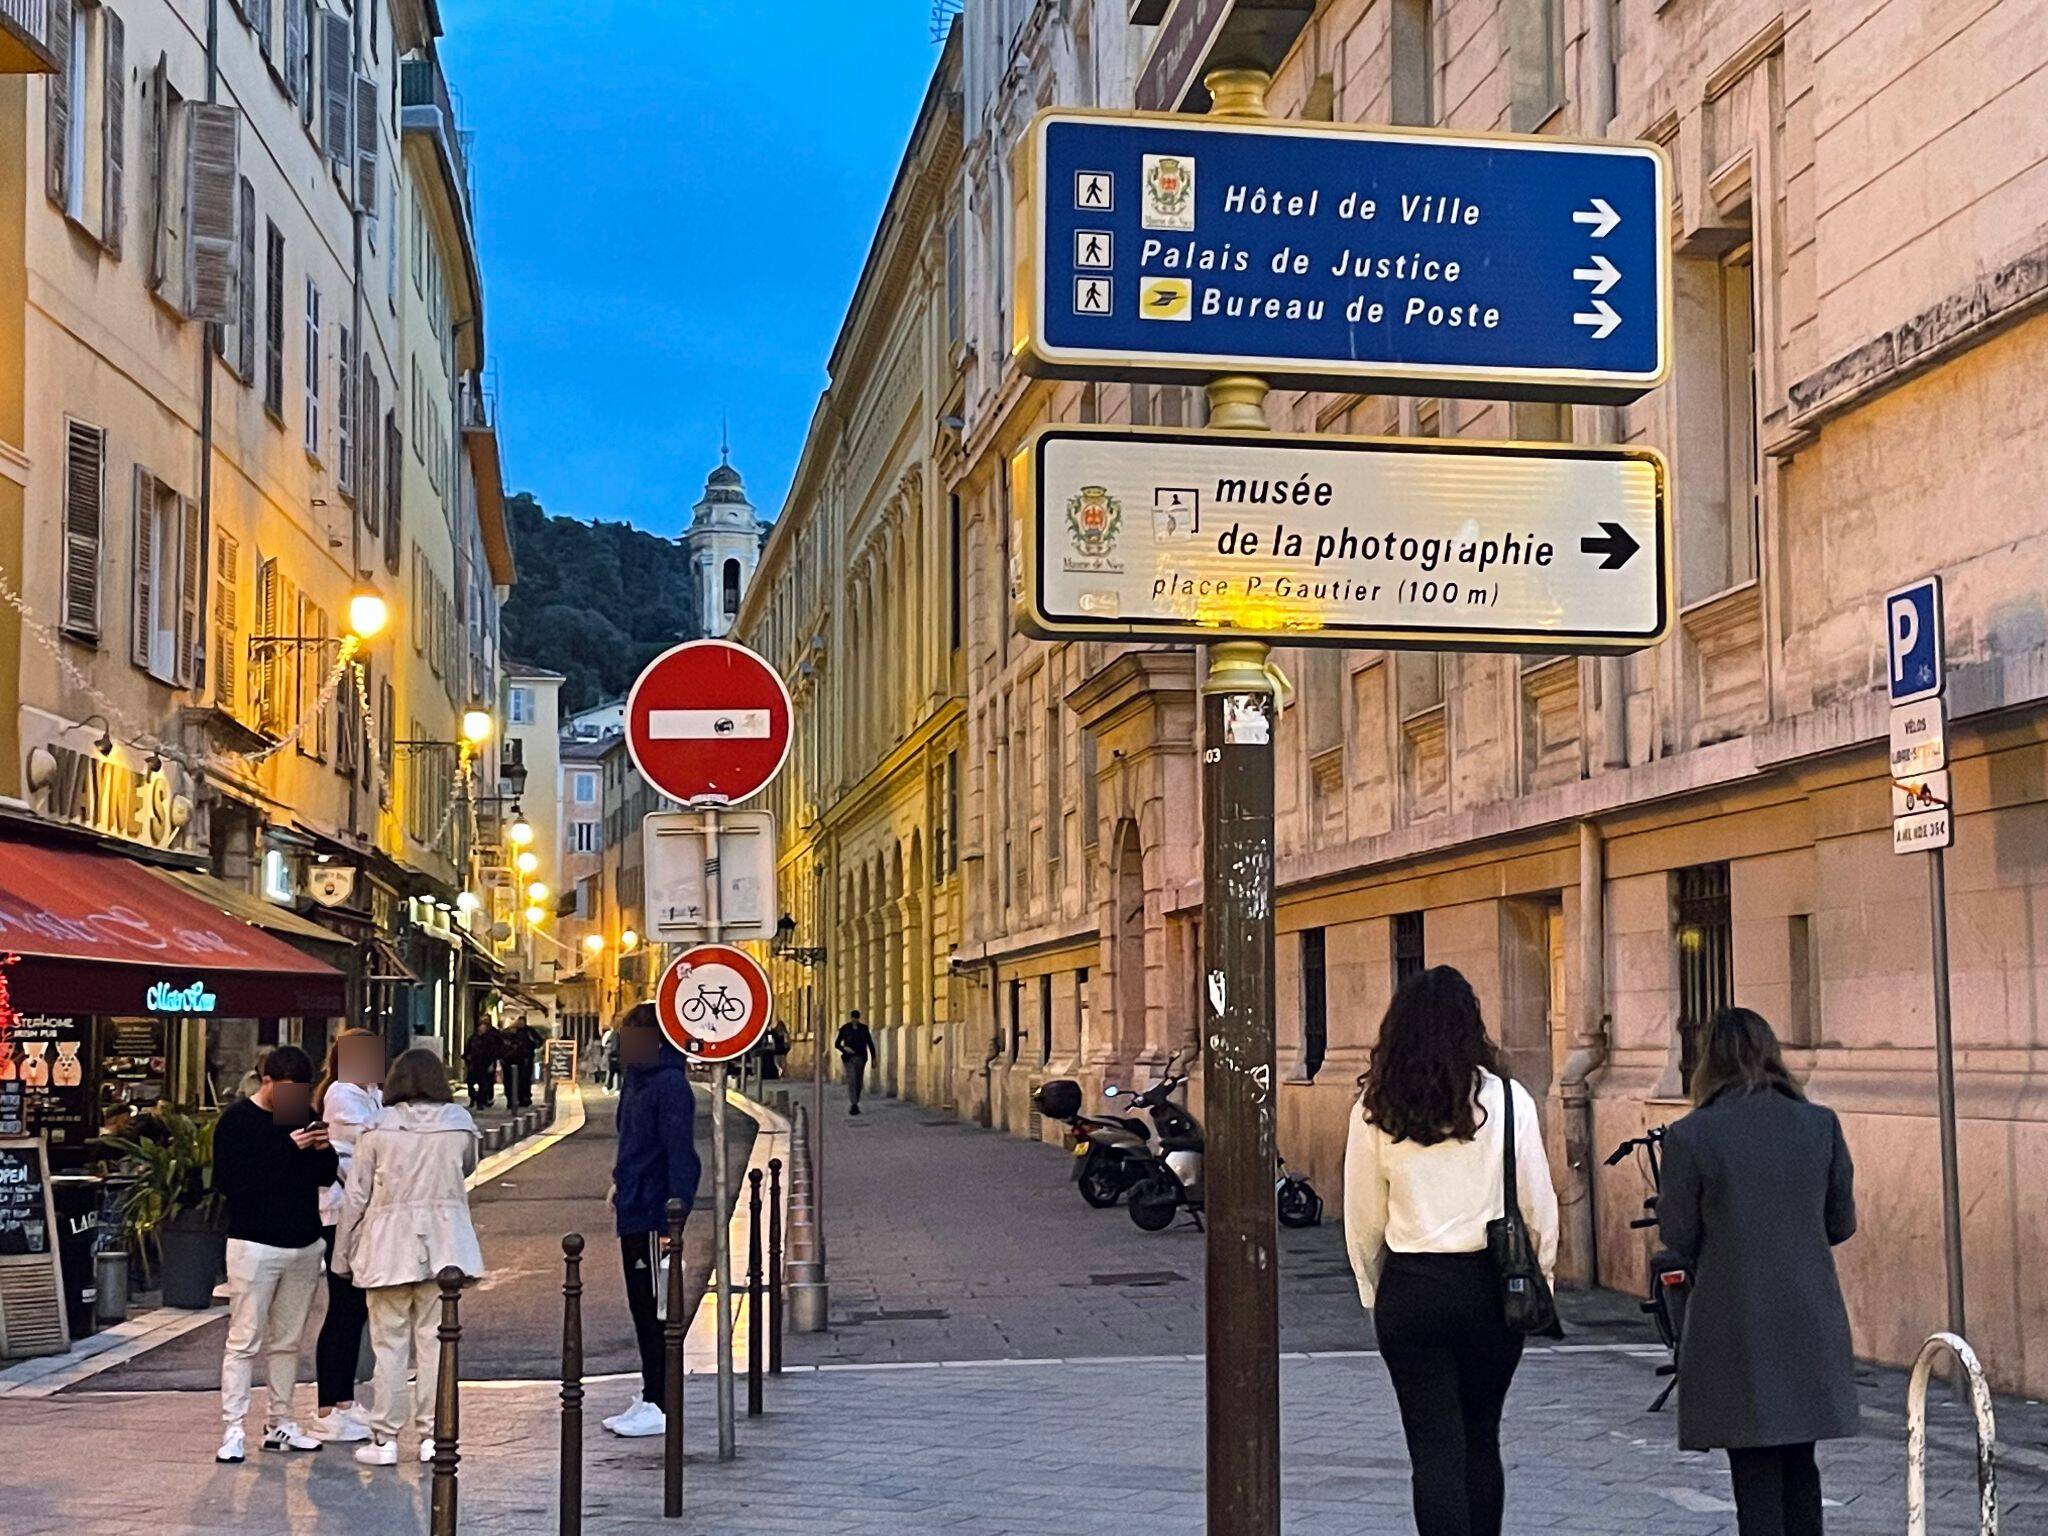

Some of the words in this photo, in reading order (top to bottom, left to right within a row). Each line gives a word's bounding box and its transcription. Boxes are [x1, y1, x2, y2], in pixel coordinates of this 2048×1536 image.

[1224, 185, 1320, 216] Hôtel
[1338, 191, 1376, 220] de
[1401, 194, 1480, 226] Ville
[1140, 239, 1249, 271] Palais
[1271, 246, 1309, 275] de
[1331, 249, 1460, 282] Justice
[1201, 287, 1325, 321] Bureau
[1346, 295, 1384, 323] de
[1404, 297, 1500, 329] Poste
[1215, 472, 1333, 507] musée
[1217, 522, 1259, 556] de
[1272, 524, 1302, 557] la
[1314, 526, 1554, 573] photographie
[1152, 573, 1229, 600] place
[1891, 598, 1919, 682] P
